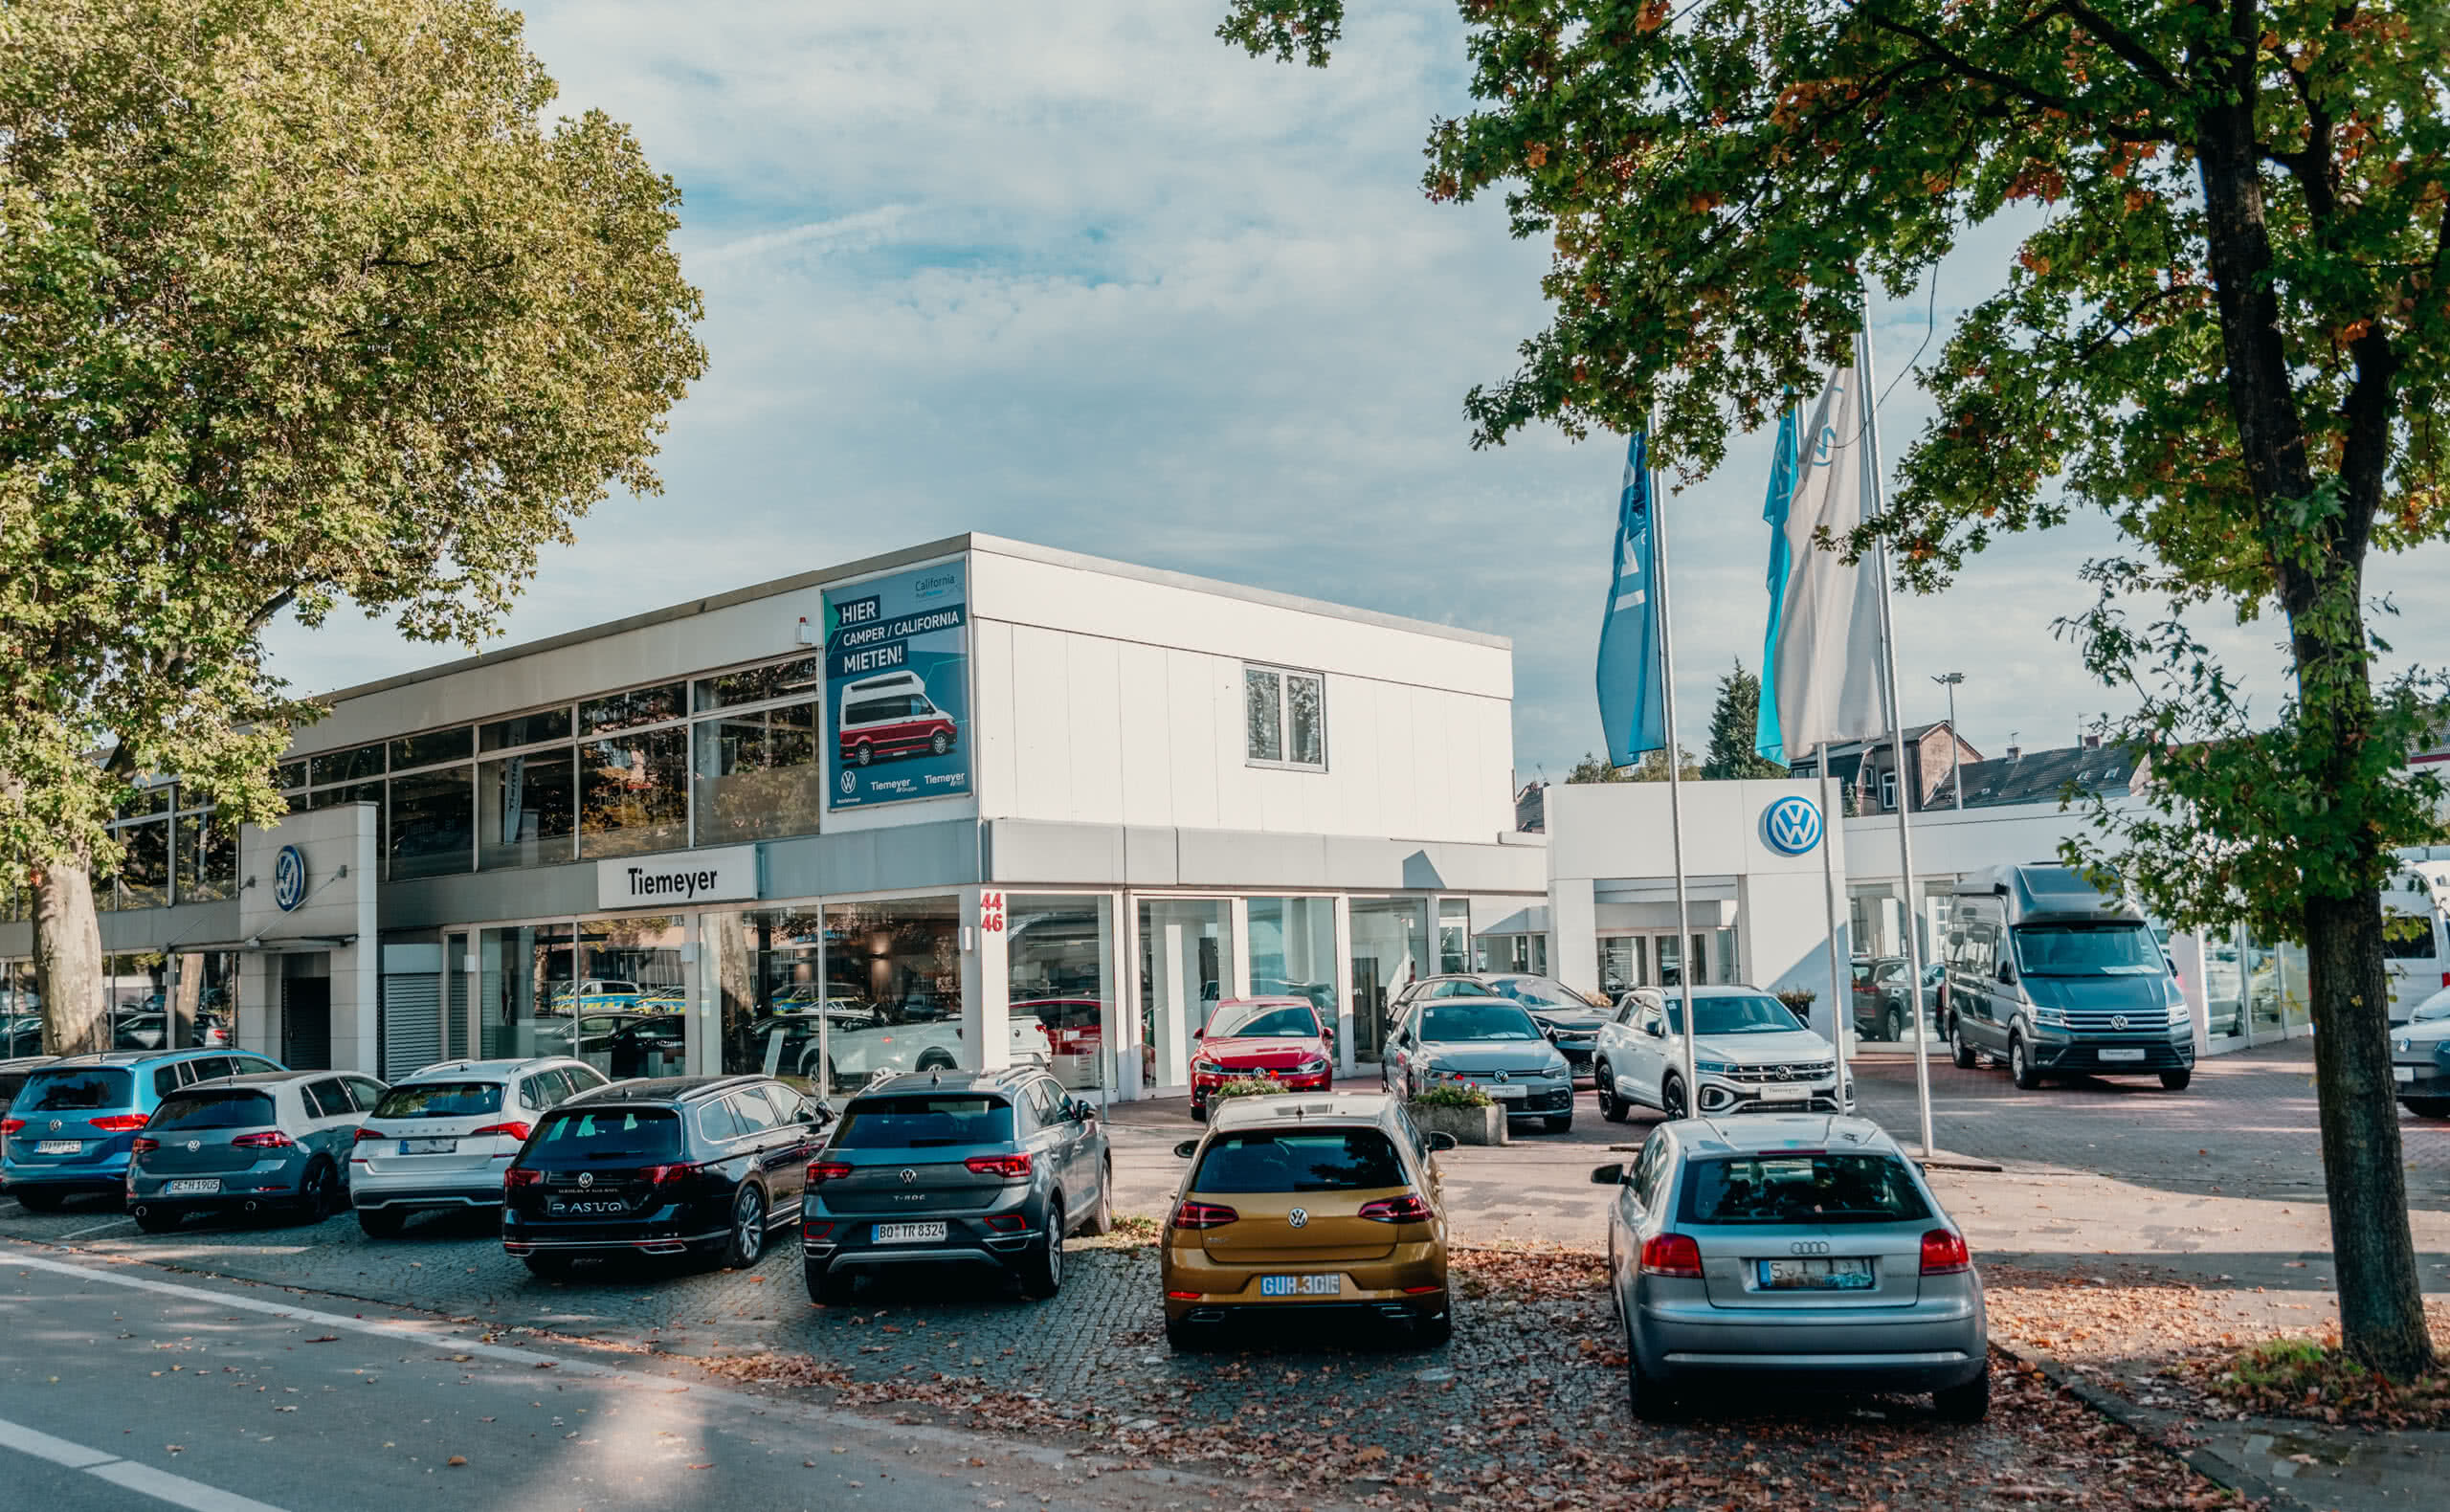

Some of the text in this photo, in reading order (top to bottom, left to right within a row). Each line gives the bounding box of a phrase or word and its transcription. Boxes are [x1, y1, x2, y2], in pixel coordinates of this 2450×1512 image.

[842, 600, 876, 624] HIER
[843, 611, 959, 646] CAMPER / CALIFORNIA
[844, 645, 902, 674] MIETEN!
[870, 778, 911, 792] Tiemeyer
[924, 773, 966, 787] Tiemeyer
[628, 867, 718, 900] Tiemeyer
[980, 893, 1003, 911] 44
[981, 913, 1004, 932] 46
[902, 1224, 916, 1238] TR
[918, 1223, 945, 1237] 8324
